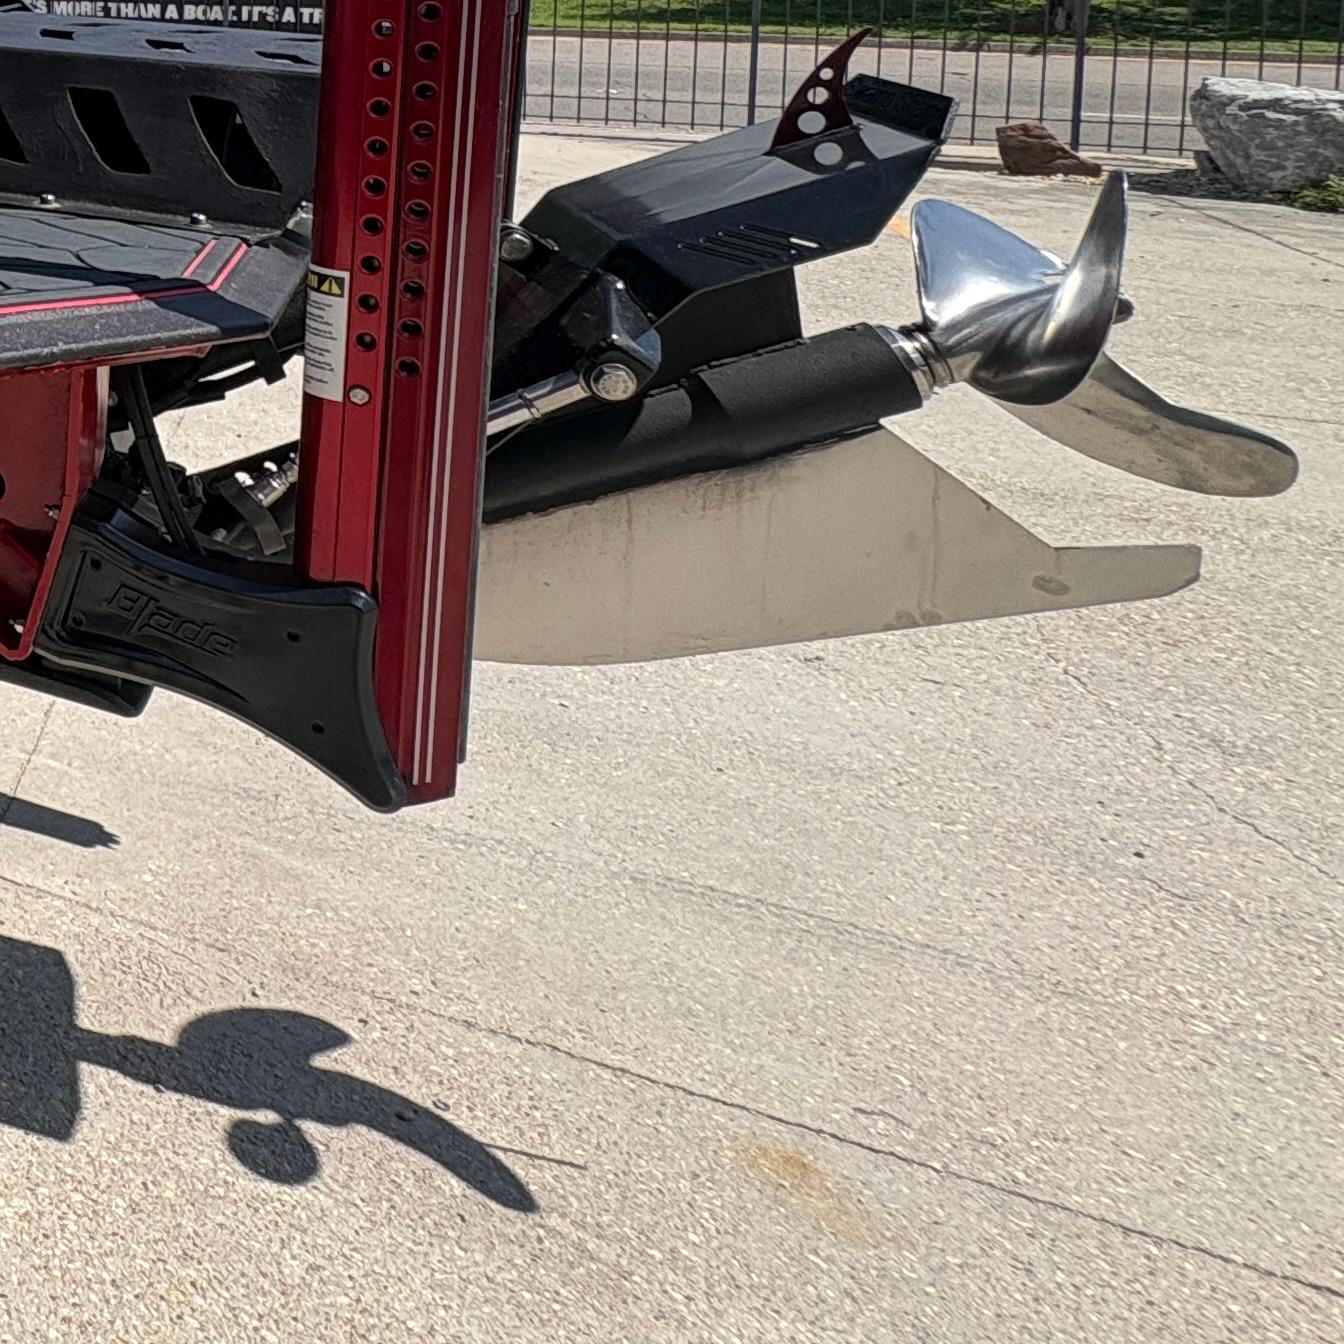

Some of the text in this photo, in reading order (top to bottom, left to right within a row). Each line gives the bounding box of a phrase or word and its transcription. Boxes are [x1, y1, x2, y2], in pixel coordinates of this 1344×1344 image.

[51, 1, 104, 17] MORE
[107, 2, 161, 19] THAN
[164, 3, 179, 20] A
[183, 5, 238, 21] BOAT.
[241, 5, 279, 23] IT'S
[282, 7, 296, 23] A
[106, 583, 240, 657] Blade
